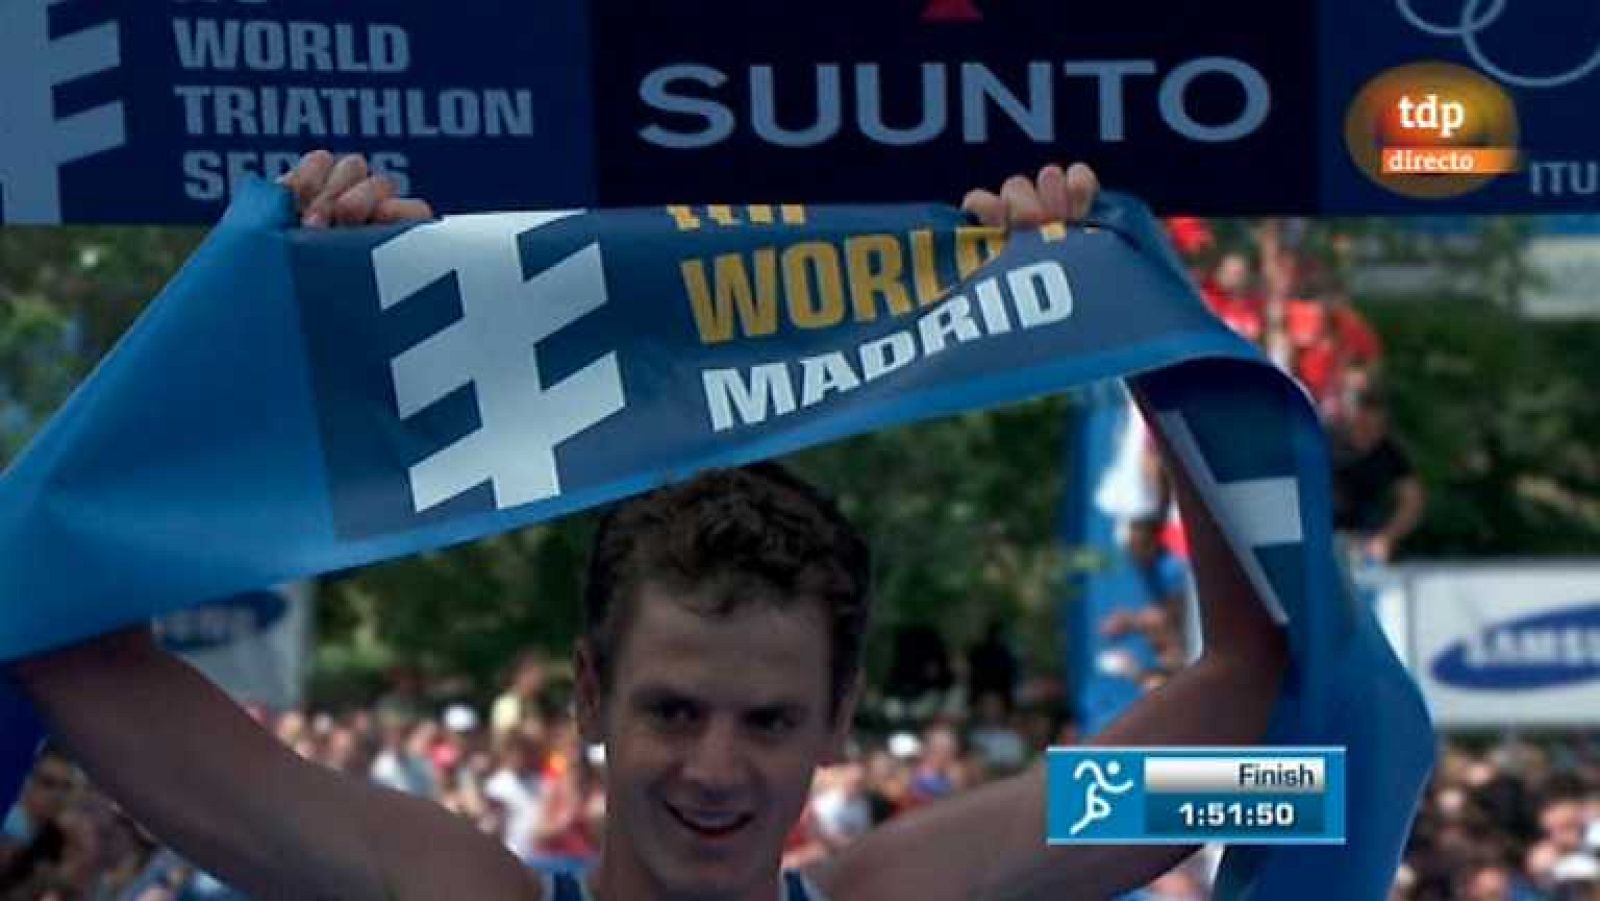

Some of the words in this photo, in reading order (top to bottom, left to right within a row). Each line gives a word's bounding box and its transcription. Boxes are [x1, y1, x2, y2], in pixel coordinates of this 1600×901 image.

[173, 18, 411, 72] WORLD
[173, 85, 534, 137] TRIATHLON
[638, 56, 1271, 149] SUUNTO
[1530, 161, 1598, 194] ITU
[702, 259, 1074, 432] MADRID
